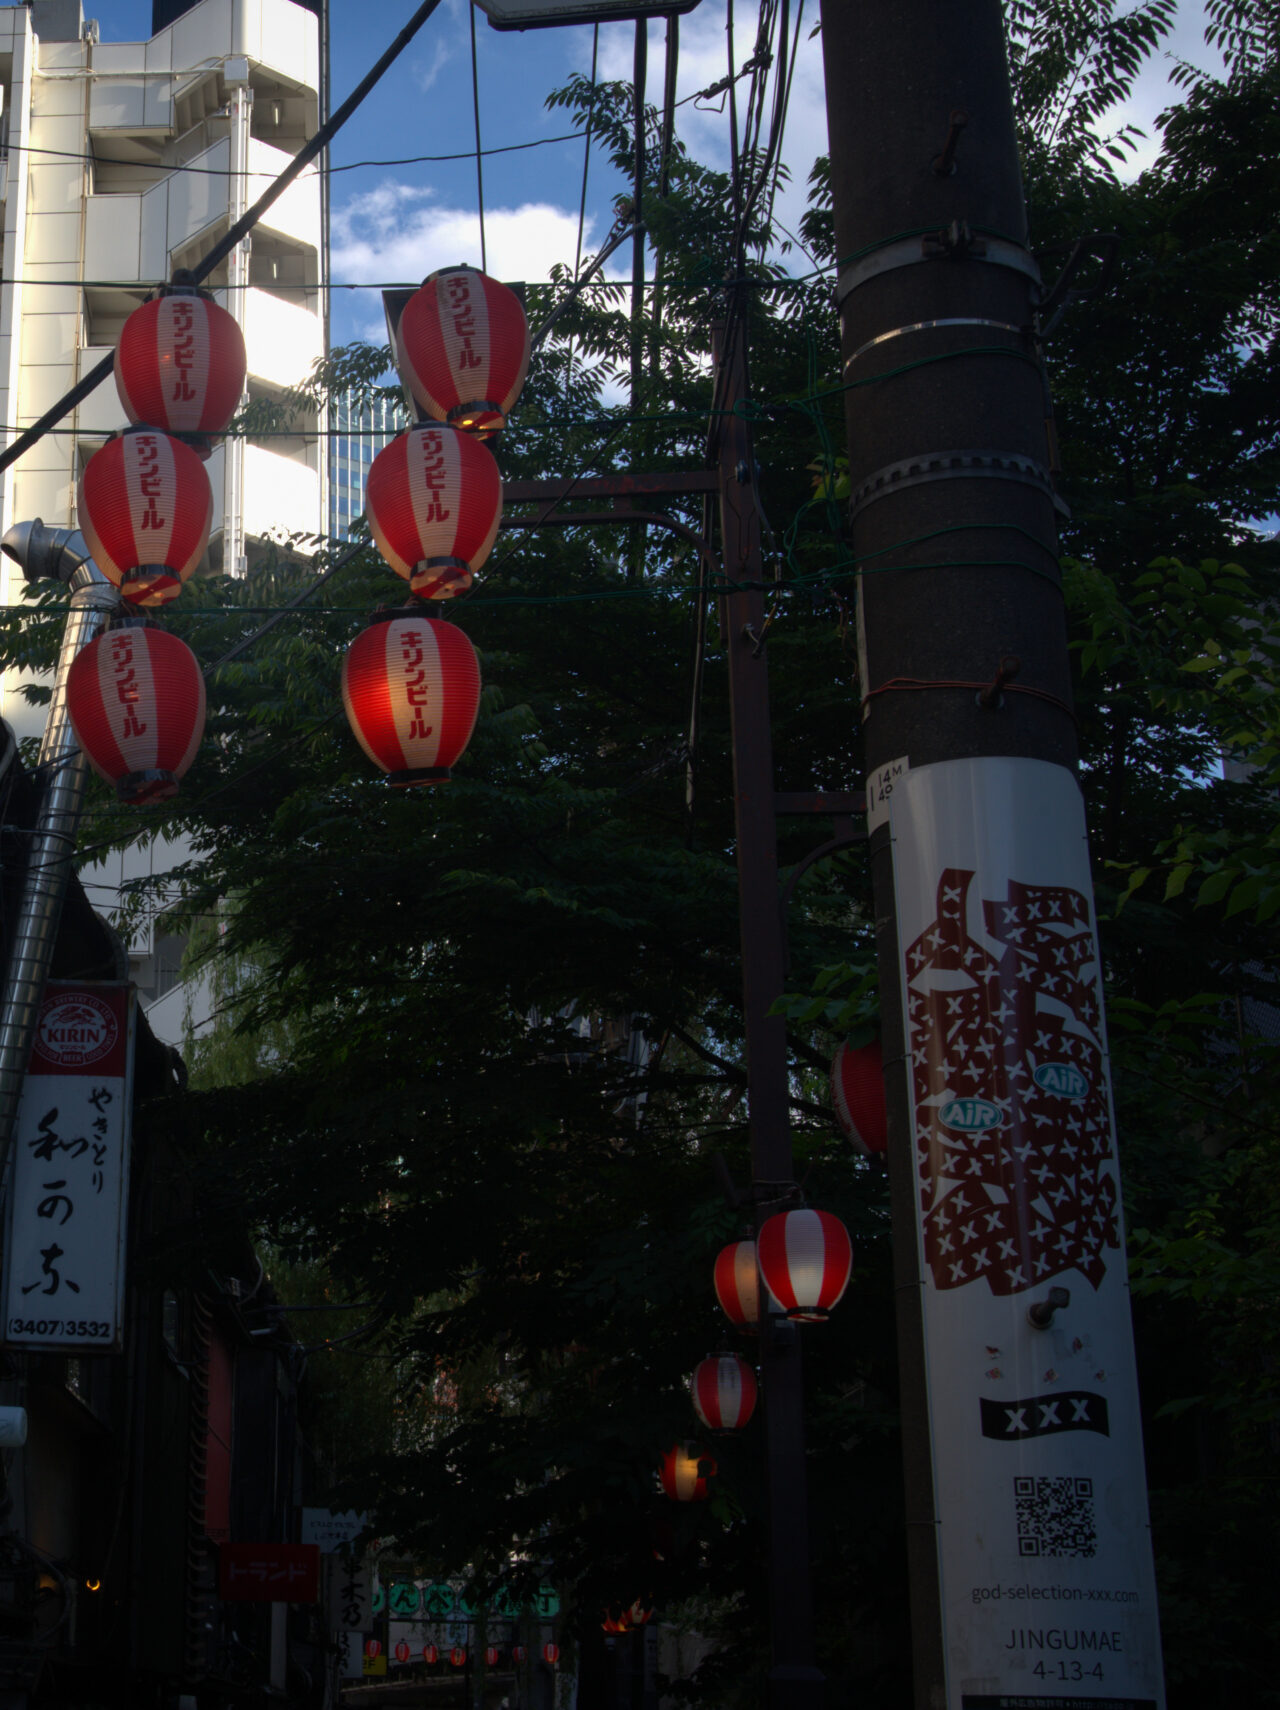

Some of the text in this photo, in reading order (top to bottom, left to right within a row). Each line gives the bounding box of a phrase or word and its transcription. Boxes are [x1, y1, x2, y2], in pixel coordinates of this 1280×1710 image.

[171, 302, 196, 401] キリンビール
[445, 275, 482, 370] キリンビール
[135, 436, 165, 530] キリンビール
[421, 430, 450, 523] キリンビール
[111, 634, 147, 739] キリンビール
[400, 631, 432, 740] キリンビール
[47, 1028, 101, 1044] KIRIN
[88, 1087, 113, 1194] やきとり
[8, 1318, 111, 1338] (3407)3532
[971, 1584, 1138, 1604] god-selection-xxx.com
[1006, 1628, 1123, 1652] JINGUMAE
[1032, 1660, 1105, 1681] 4-13-4
